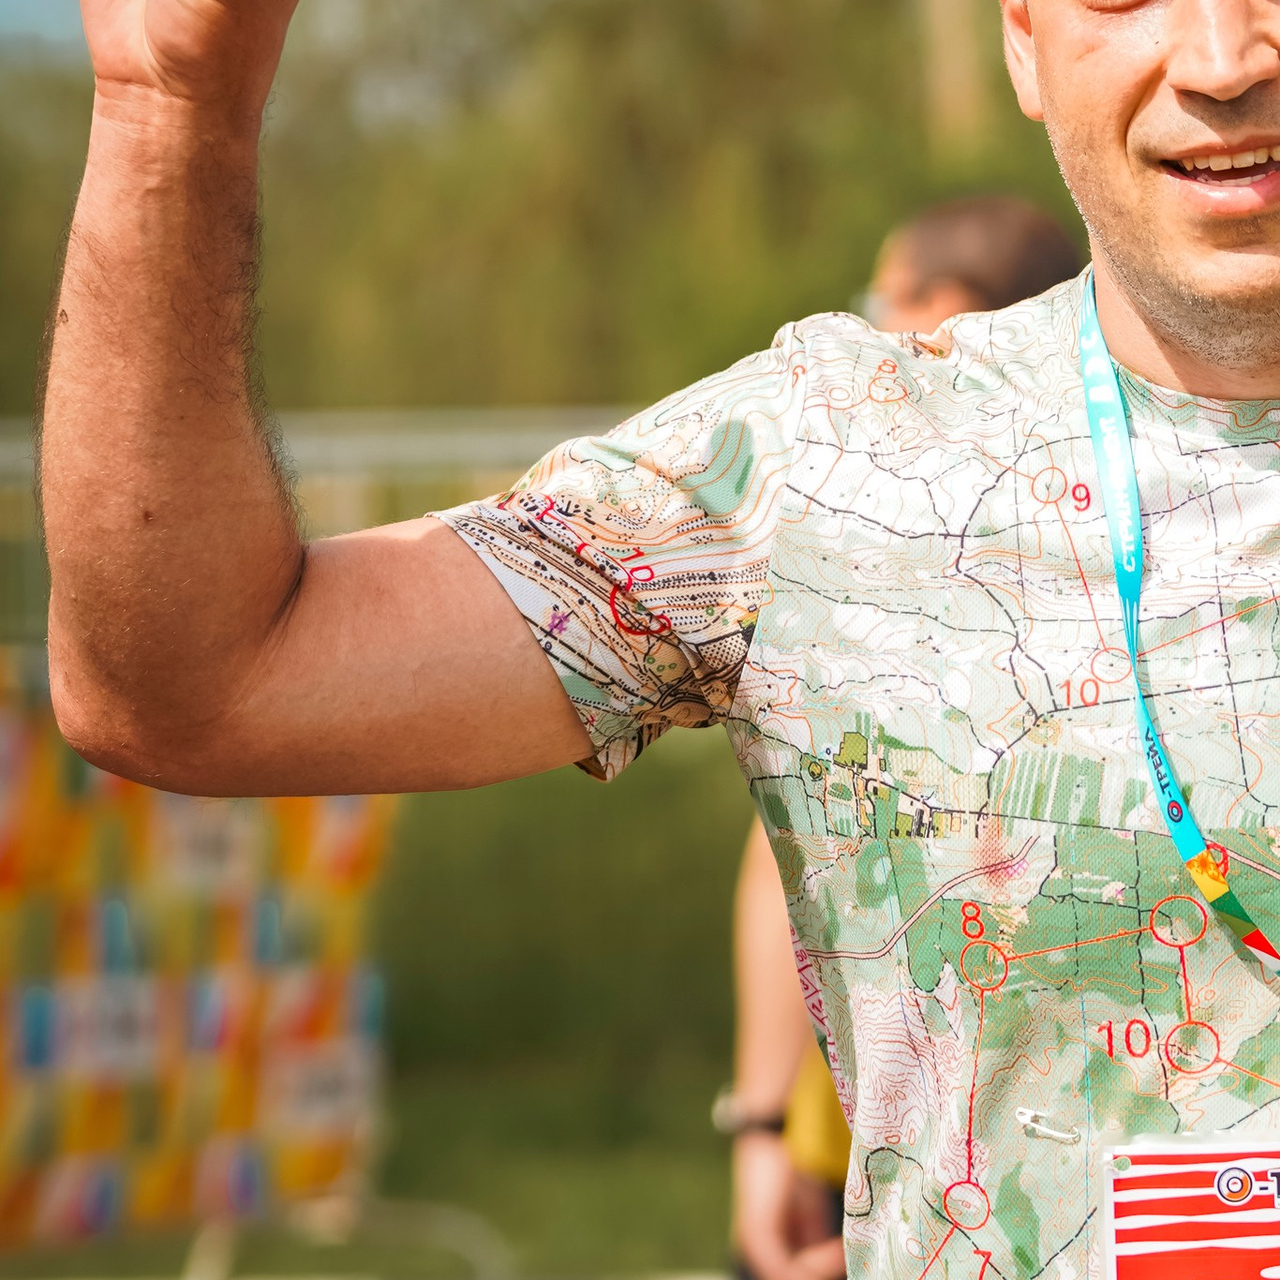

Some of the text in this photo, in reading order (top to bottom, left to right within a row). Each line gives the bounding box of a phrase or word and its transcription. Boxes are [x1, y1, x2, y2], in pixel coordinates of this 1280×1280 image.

[1072, 483, 1091, 511] 9
[1061, 678, 1099, 708] 10
[962, 901, 984, 939] 8
[1099, 1019, 1152, 1059] 10
